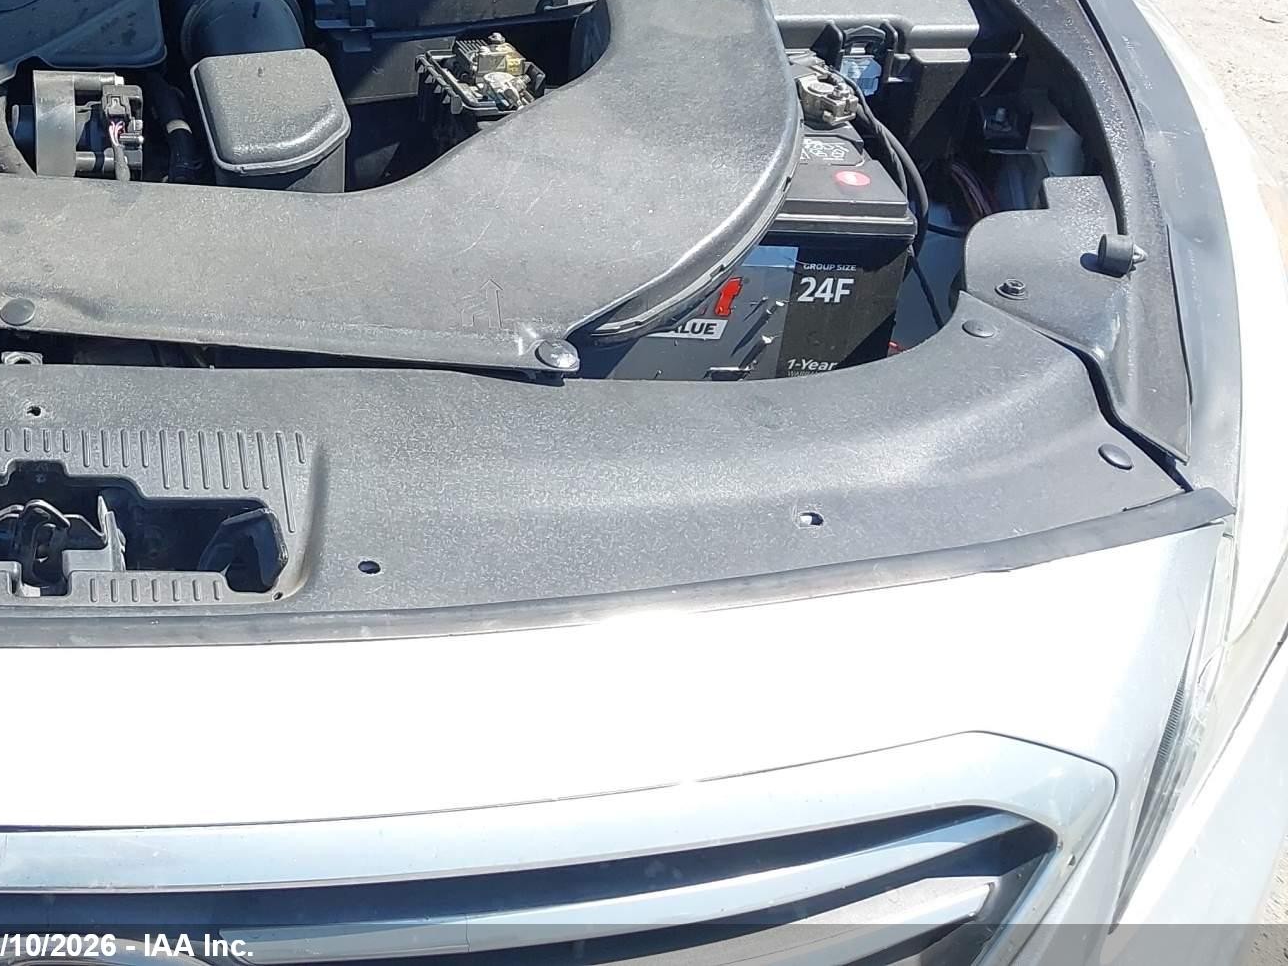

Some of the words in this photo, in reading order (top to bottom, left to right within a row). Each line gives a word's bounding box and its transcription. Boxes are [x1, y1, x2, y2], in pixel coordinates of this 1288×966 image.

[803, 263, 836, 271] GROUP
[836, 264, 857, 272] SIZE
[797, 276, 855, 303] 24F
[787, 358, 838, 371] 1-Year
